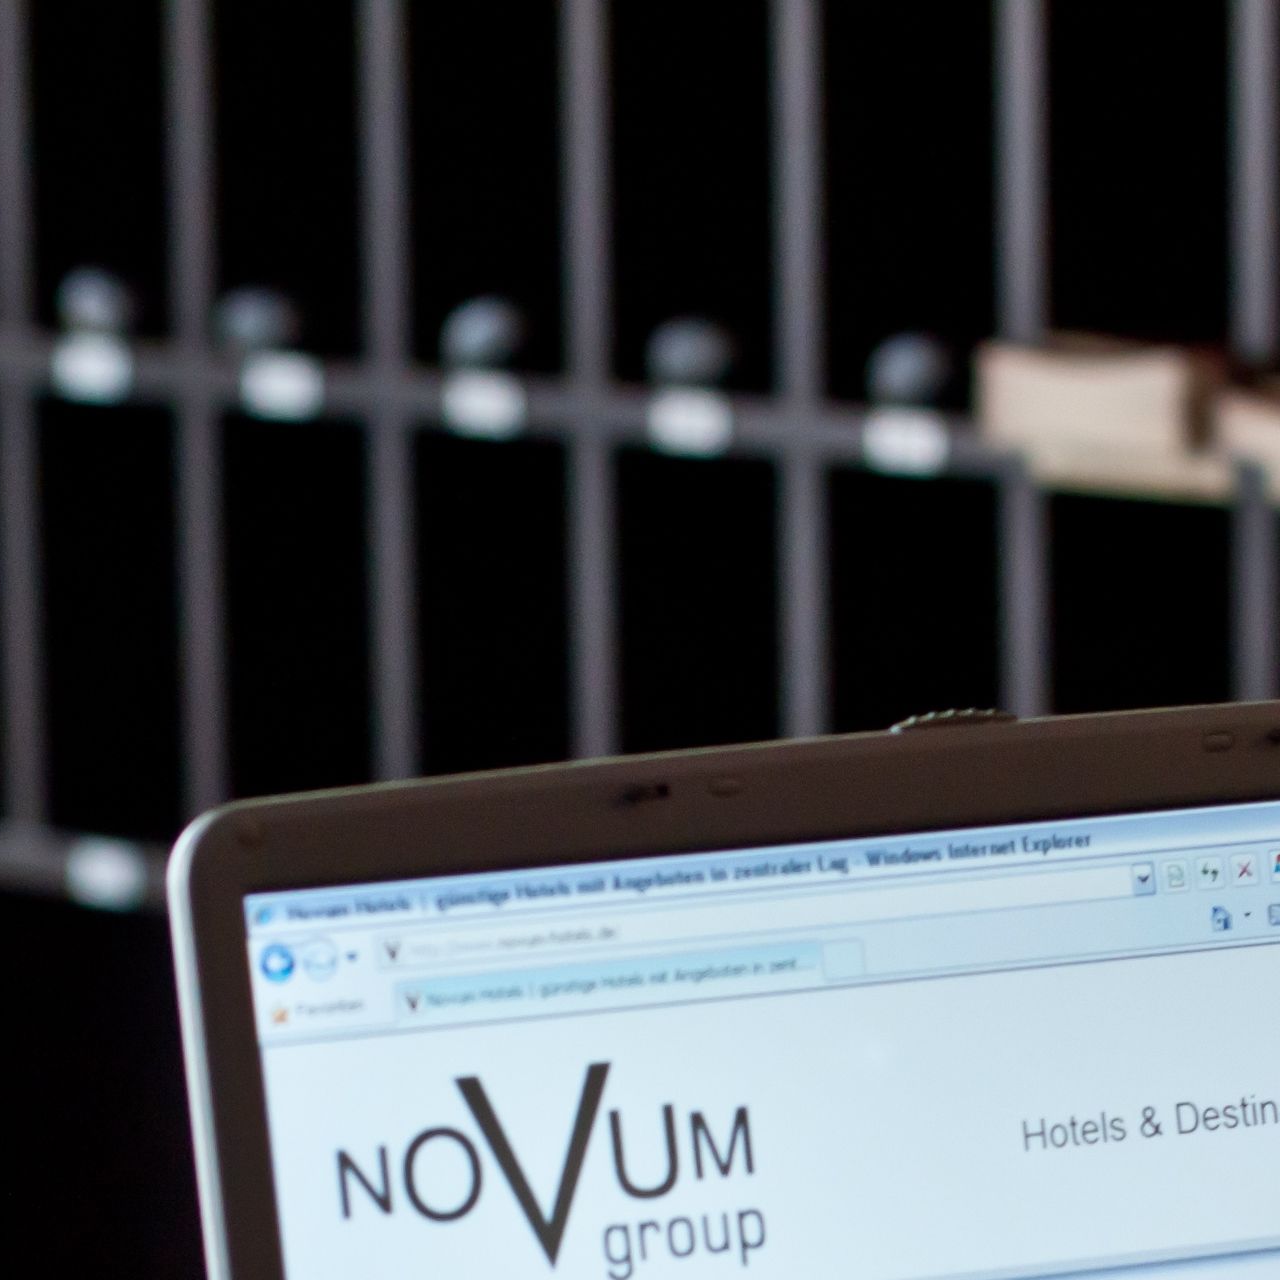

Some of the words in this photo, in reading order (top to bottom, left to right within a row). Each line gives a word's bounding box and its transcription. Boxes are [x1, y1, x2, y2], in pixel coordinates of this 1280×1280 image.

[614, 872, 706, 896] Angeboten
[818, 854, 849, 875] Lag
[865, 847, 943, 868] Windows
[948, 840, 1017, 861] Internet
[1022, 833, 1092, 856] Explorer
[1022, 1111, 1127, 1153] Hotels
[1138, 1105, 1164, 1139] &
[335, 1061, 756, 1270] NOVUM
